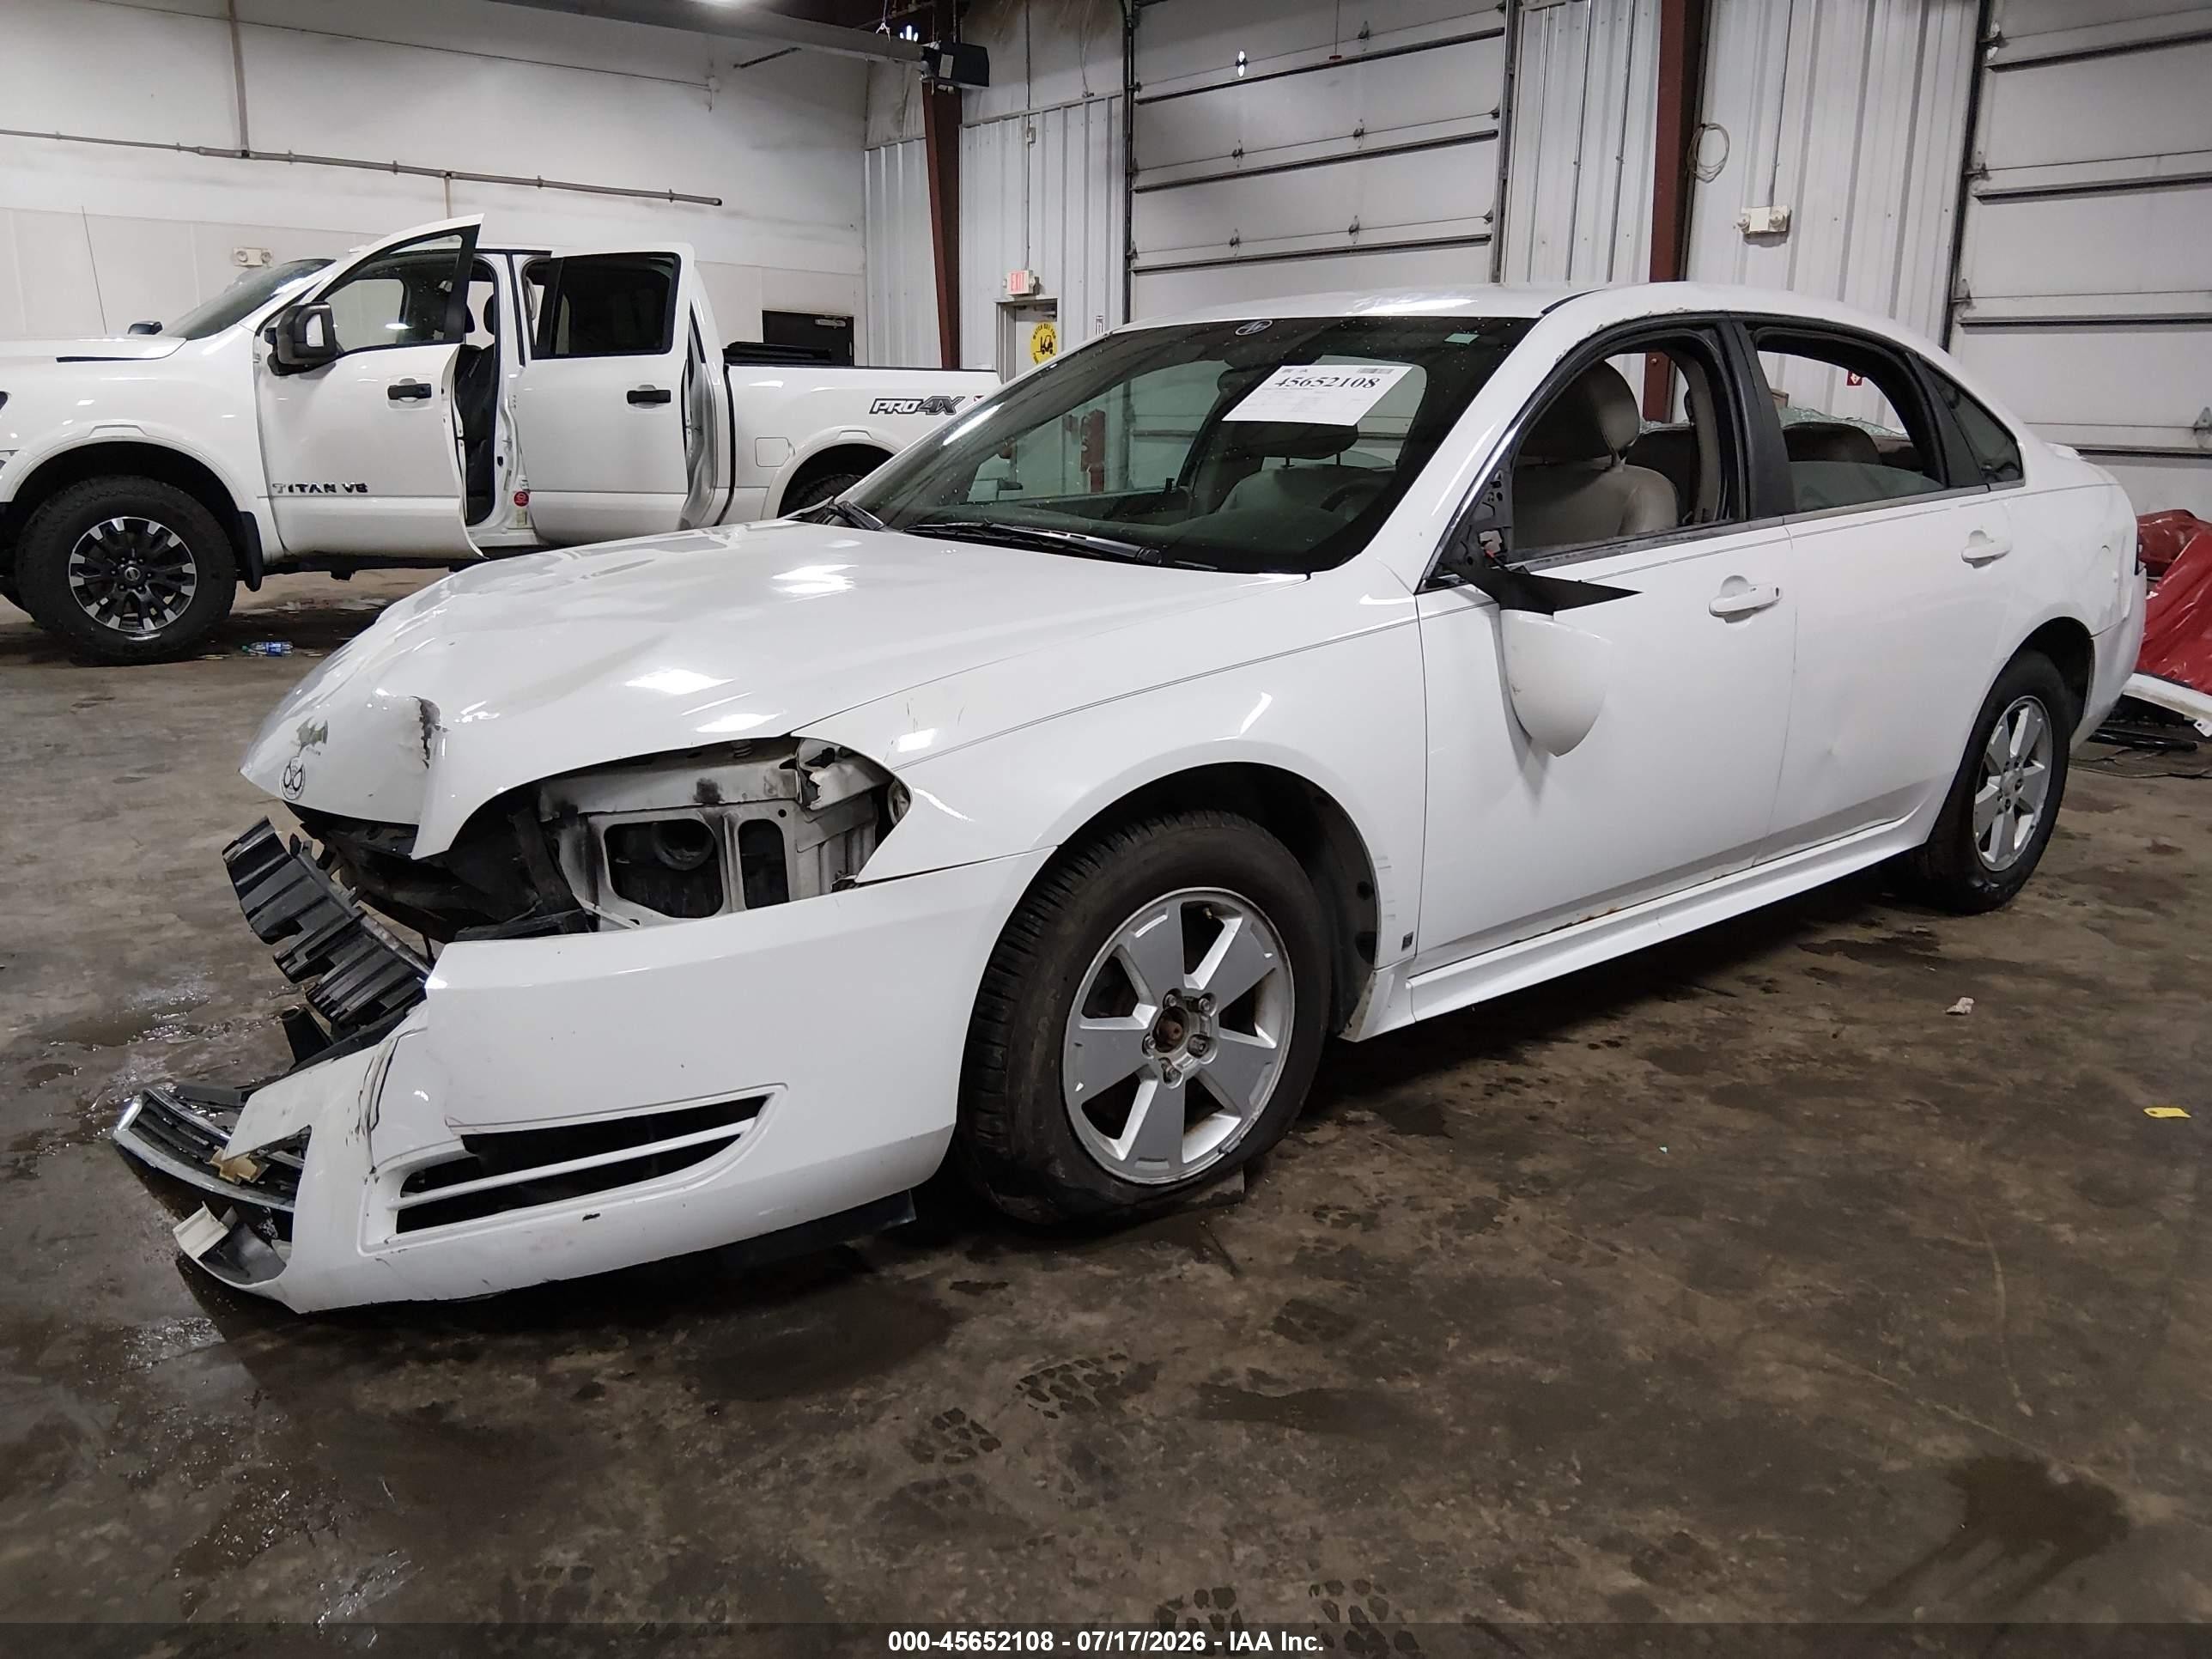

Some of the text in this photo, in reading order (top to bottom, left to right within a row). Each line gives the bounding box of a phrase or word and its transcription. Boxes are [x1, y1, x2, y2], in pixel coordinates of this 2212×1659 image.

[1011, 272, 1025, 292] EXIT
[1274, 376, 1381, 389] 45652108
[272, 482, 369, 494] TITAN V8
